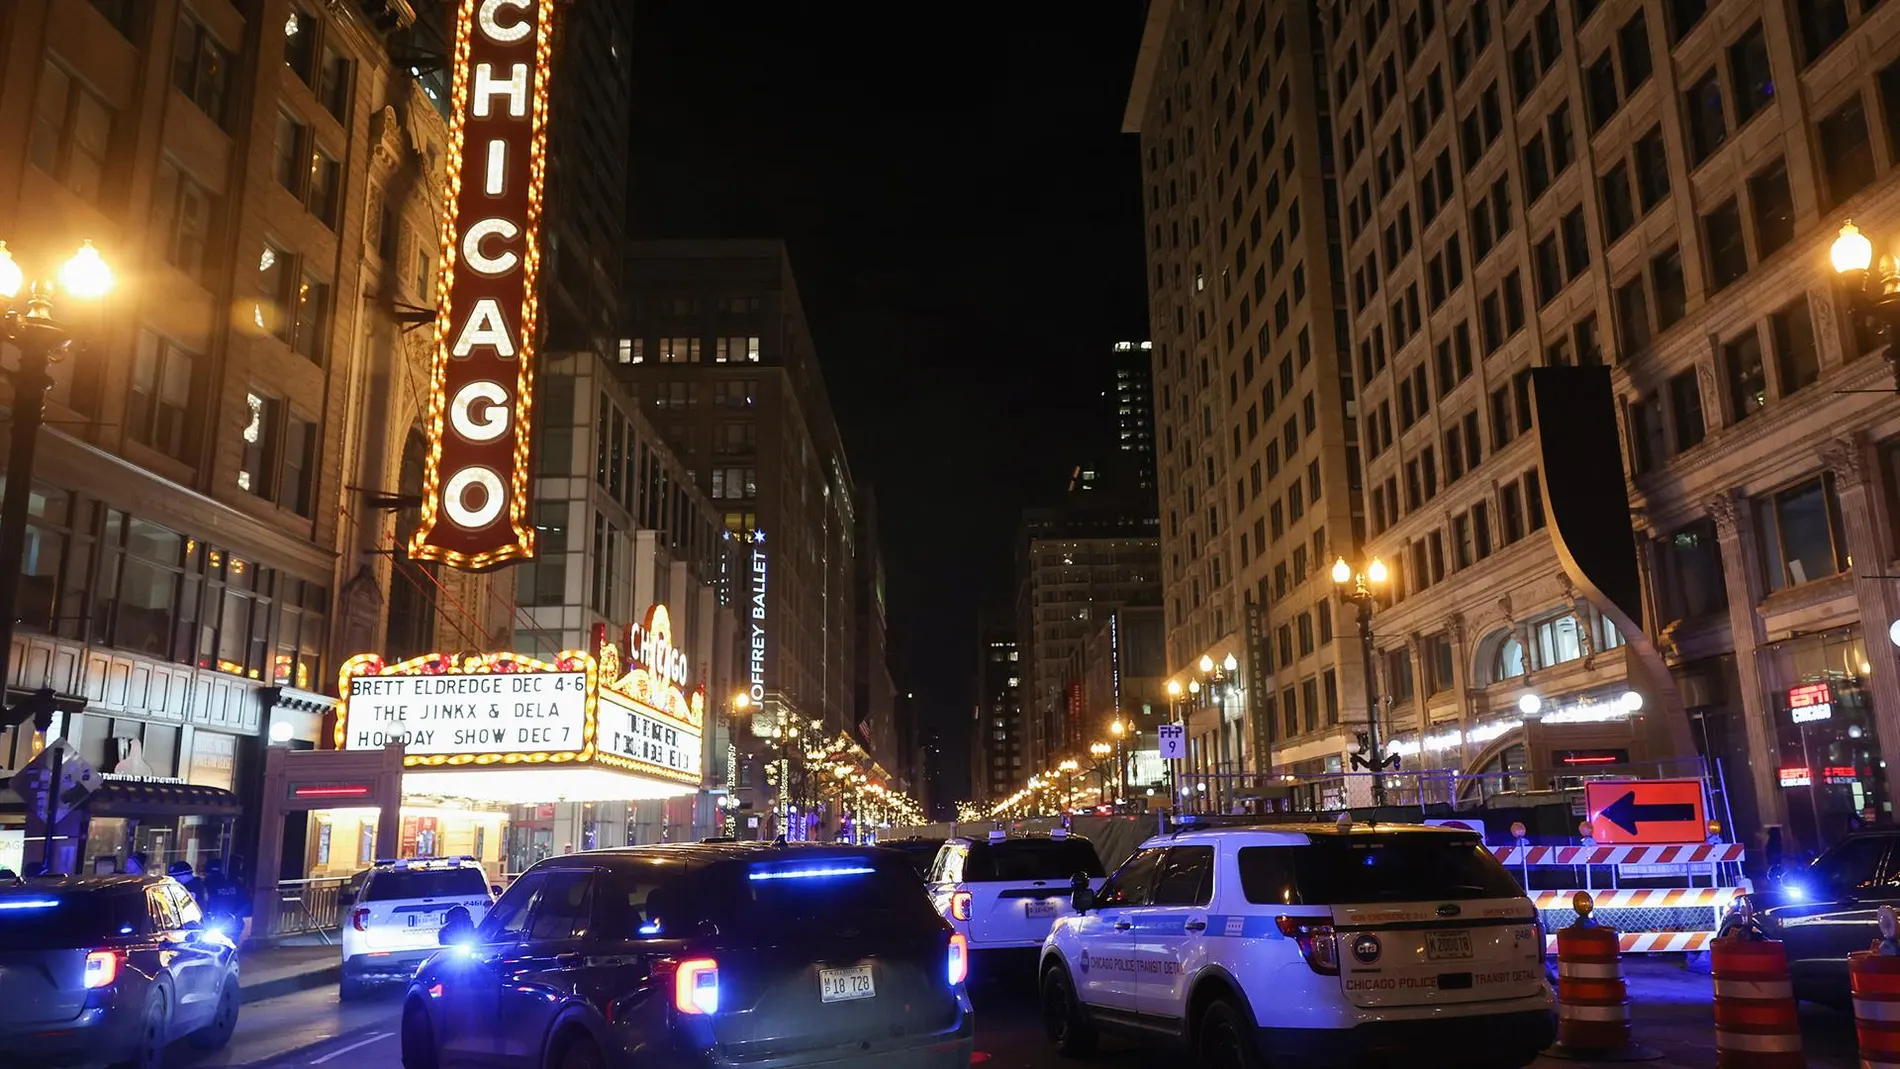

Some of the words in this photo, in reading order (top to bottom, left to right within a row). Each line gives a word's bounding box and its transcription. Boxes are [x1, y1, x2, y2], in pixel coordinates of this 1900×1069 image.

[444, 0, 532, 528] CHICAGO
[752, 549, 766, 620] BALLET
[631, 622, 687, 686] CHICAGO
[751, 623, 765, 711] JOFFREY
[352, 679, 405, 696] BRETT
[414, 677, 503, 695] ELDREDGE
[512, 677, 543, 693] DEC
[555, 676, 584, 692] 4-6
[1253, 651, 1264, 708] SISKEL
[373, 705, 408, 721] THE
[420, 704, 477, 720] JINKX
[488, 703, 500, 719] &
[514, 702, 560, 718] DELA
[358, 730, 435, 747] HOLDAY
[454, 728, 506, 745] SHOW
[518, 727, 552, 743] DEC
[562, 726, 571, 742] 7
[1168, 740, 1177, 753] 9
[1357, 942, 1377, 954] cta
[1090, 956, 1113, 970] CHICAGO
[1114, 958, 1135, 972] POLICE
[1136, 959, 1162, 974] TRANSIT
[833, 978, 846, 995] 18
[850, 975, 870, 992] 728
[1346, 978, 1395, 991] CHICAGO
[1399, 976, 1436, 989] POLICE
[1475, 971, 1511, 986] TRANSIT
[1512, 969, 1537, 982] DETAIL
